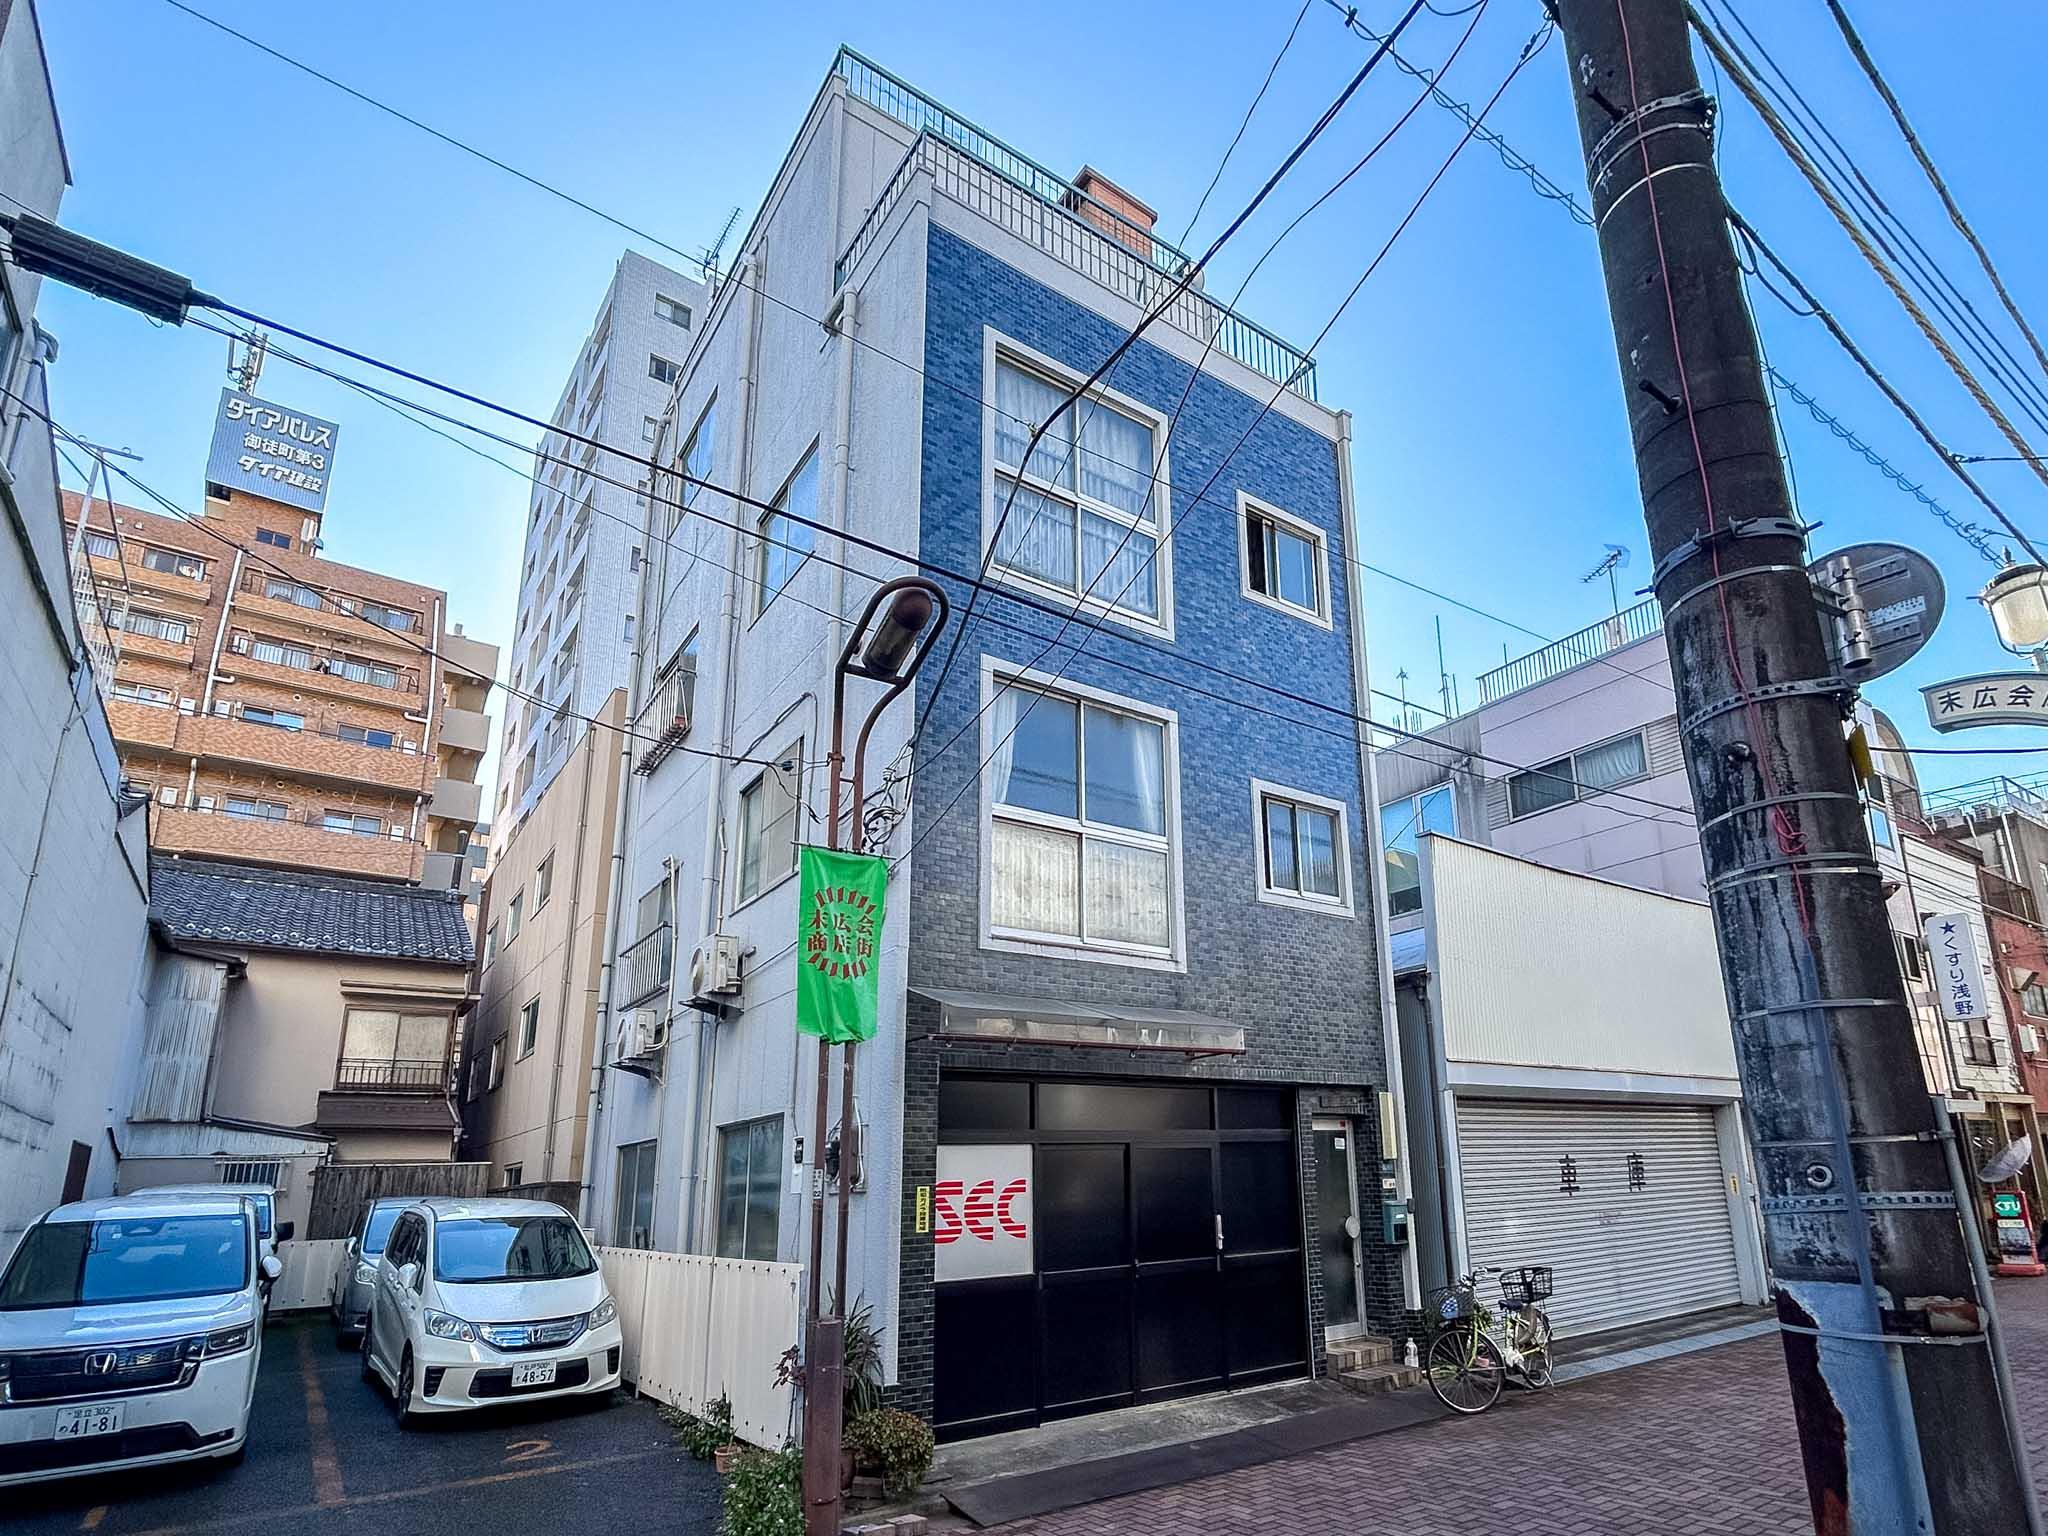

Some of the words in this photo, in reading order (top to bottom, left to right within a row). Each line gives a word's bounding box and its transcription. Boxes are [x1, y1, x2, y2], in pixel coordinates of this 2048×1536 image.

[226, 397, 332, 449] ダイアパレス
[243, 432, 325, 470] 御徒町第3
[238, 455, 322, 493] ダイア建設
[1938, 684, 2048, 714] 末広会
[807, 931, 874, 958] 商店街
[1943, 937, 1974, 1016] くすり浅野
[934, 1178, 1027, 1245] SEC
[521, 1369, 554, 1383] 48-57
[69, 1416, 117, 1435] 41-81
[94, 1406, 111, 1416] 302
